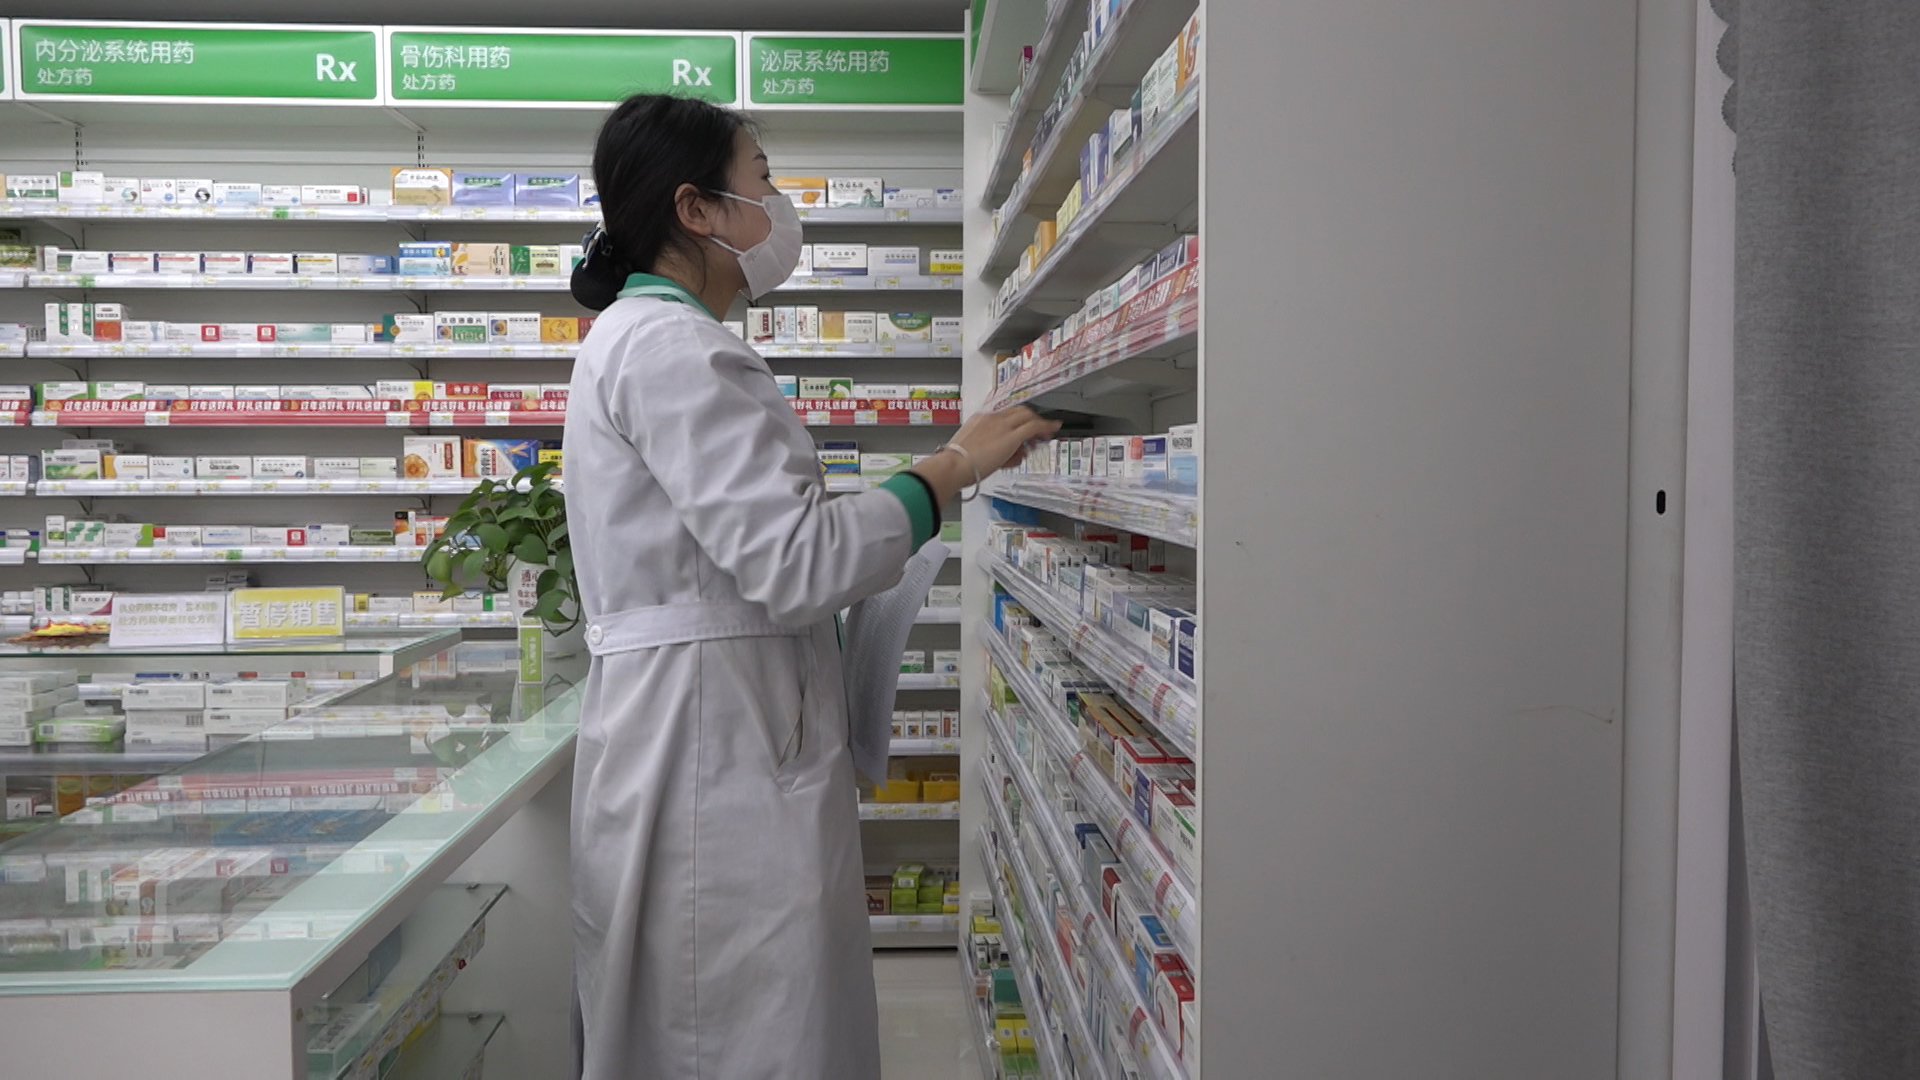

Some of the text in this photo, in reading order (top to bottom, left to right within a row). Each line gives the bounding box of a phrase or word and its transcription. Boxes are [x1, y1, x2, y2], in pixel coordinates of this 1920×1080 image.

[35, 39, 195, 65] 内分泌系统用药
[400, 45, 511, 70] 骨伤科用药
[760, 49, 889, 73] 泌尿系统用药
[37, 68, 92, 86] 处方药
[315, 53, 357, 82] Rx
[672, 58, 712, 87] Rx
[402, 73, 456, 91] 处方药
[763, 78, 815, 95] 处方药
[240, 600, 337, 629] 暂停销售
